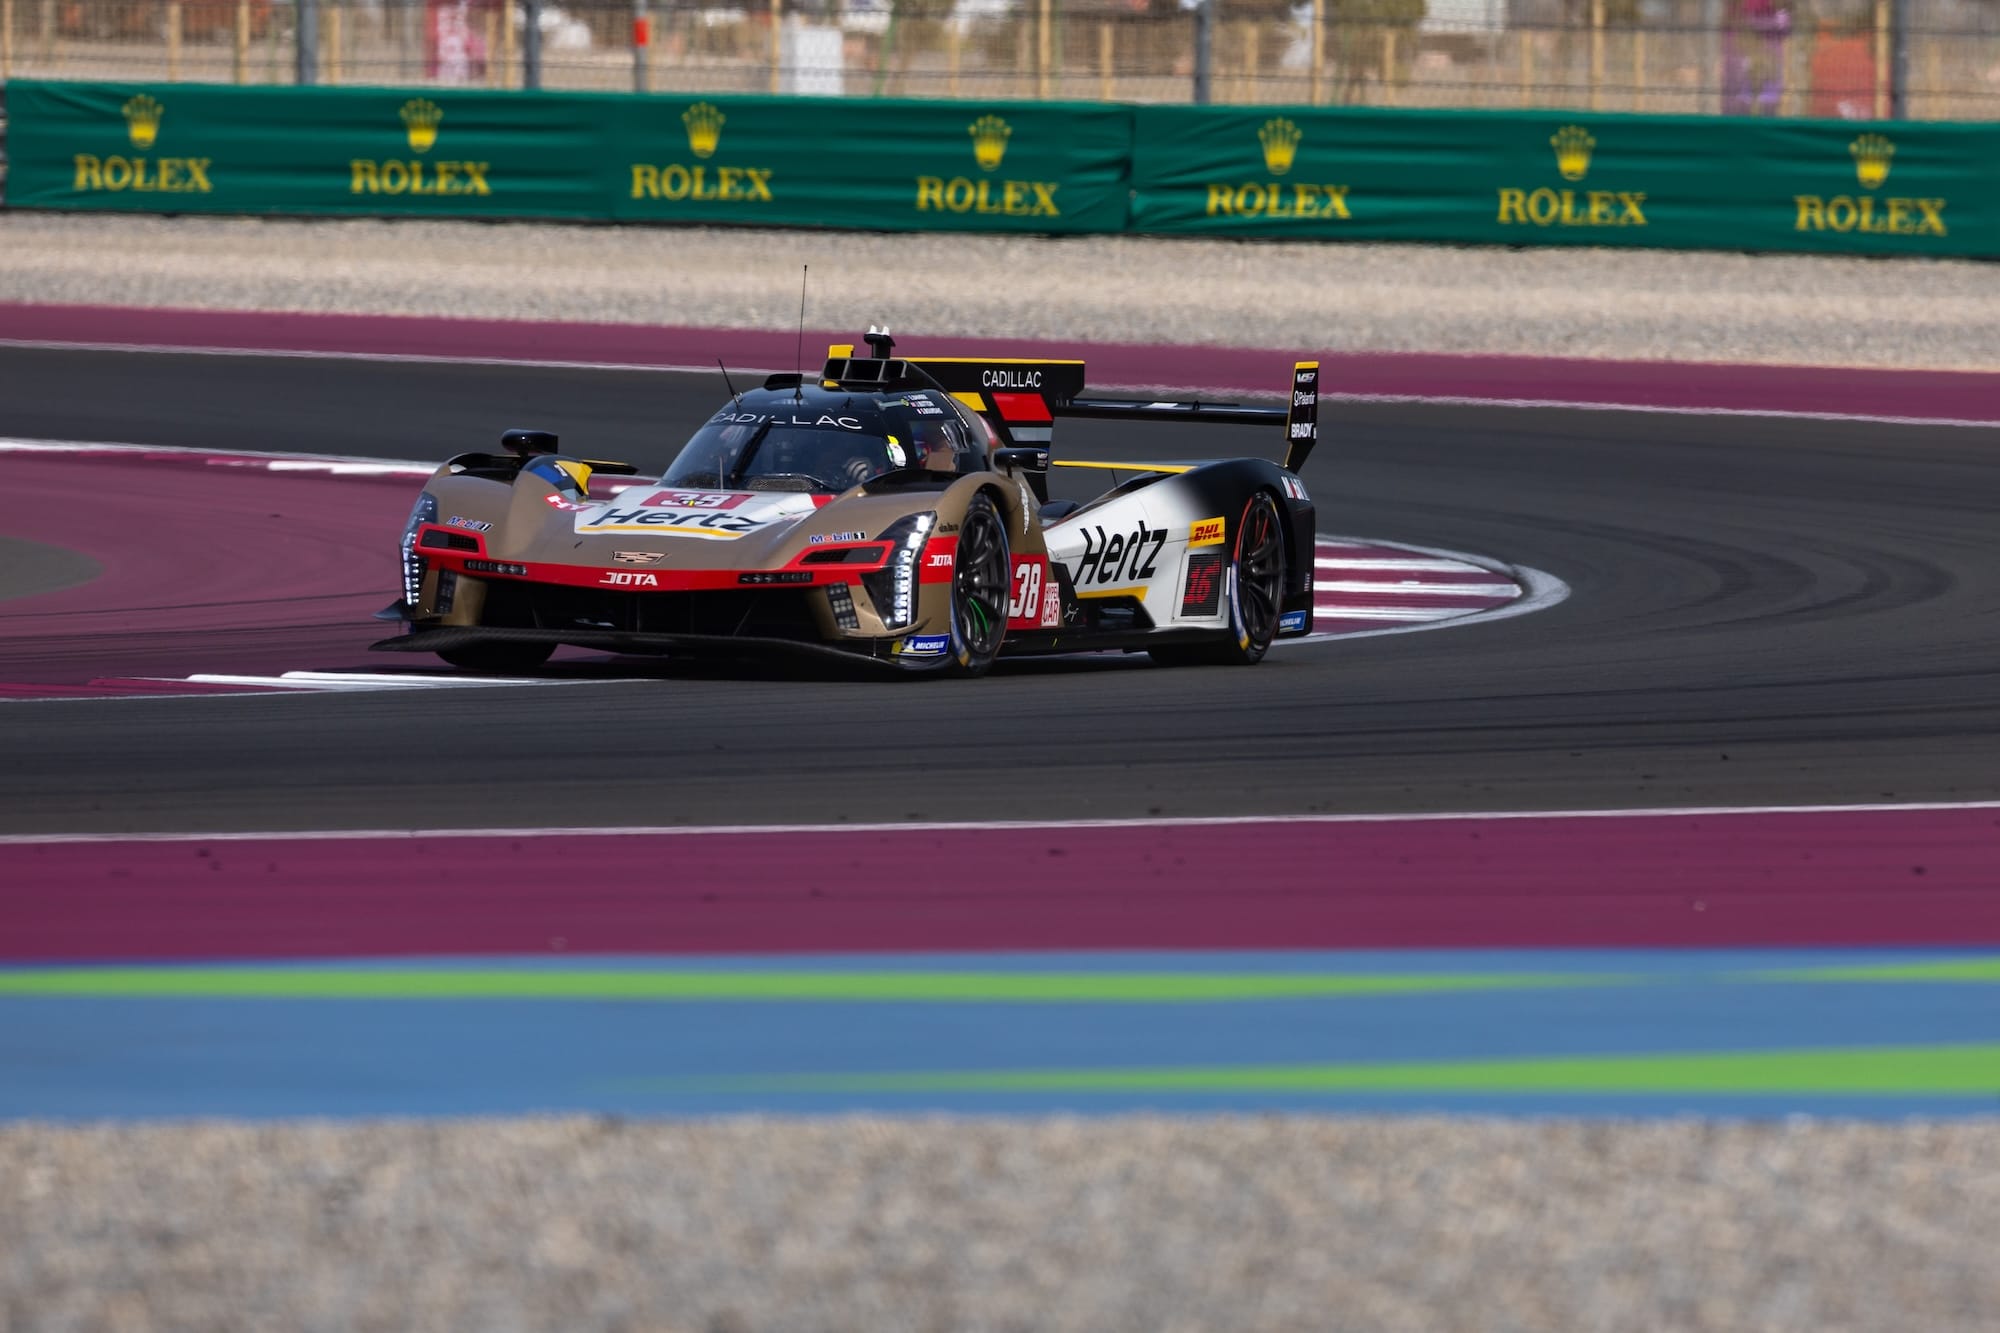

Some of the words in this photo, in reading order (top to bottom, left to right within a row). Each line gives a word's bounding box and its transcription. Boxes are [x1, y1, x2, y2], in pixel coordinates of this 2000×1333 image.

[73, 153, 213, 193] ROLEX
[350, 160, 491, 196] ROLEX
[631, 165, 772, 201] ROLEX
[916, 176, 1060, 217] ROLEX
[1206, 183, 1351, 220] ROLEX
[1497, 187, 1648, 226] ROLEX
[1794, 195, 1947, 236] ROLEX
[982, 370, 1042, 388] CADILLAC
[710, 412, 863, 430] CADILLAC
[1291, 423, 1313, 439] BRADY
[588, 508, 768, 532] Hertz
[809, 533, 850, 544] Mobil
[1073, 520, 1168, 586] Hertz
[927, 554, 953, 567] JOTA
[599, 572, 658, 586] JOTA
[1008, 563, 1042, 618] 38
[1042, 600, 1059, 624] CAR
